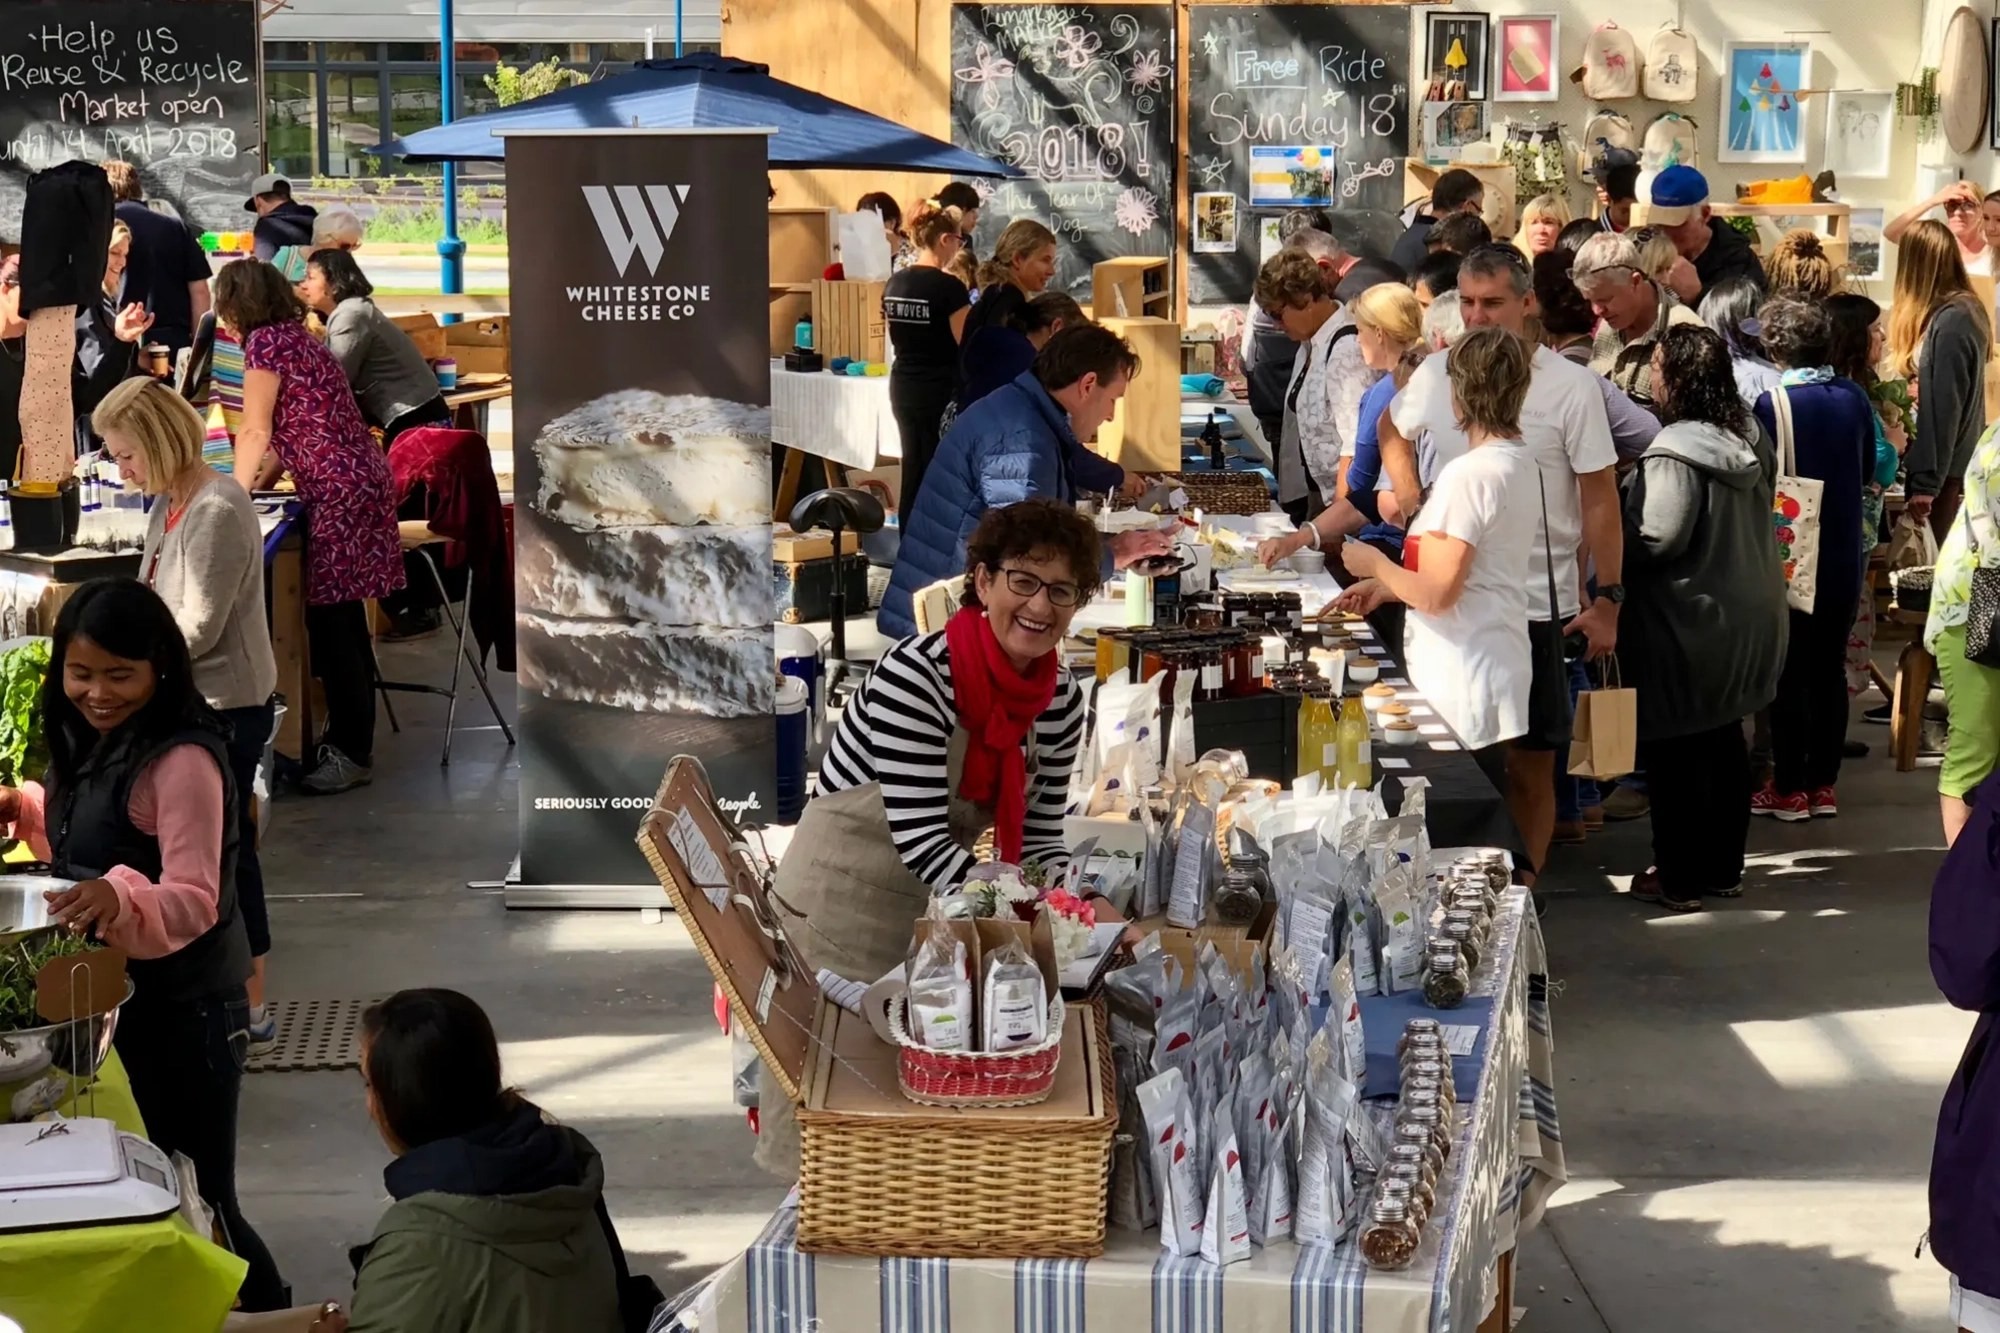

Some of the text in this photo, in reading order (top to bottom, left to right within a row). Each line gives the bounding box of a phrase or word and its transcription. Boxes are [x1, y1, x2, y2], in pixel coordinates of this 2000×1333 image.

[41, 20, 179, 61] Help us
[1, 52, 249, 98] Reuse & Recycle
[1233, 45, 1386, 85] Free Ride
[58, 89, 224, 125] Market open
[1209, 92, 1350, 148] Sunday
[63, 128, 88, 159] 14
[103, 125, 153, 162] April
[167, 127, 238, 159] 2018
[1050, 212, 1088, 243] Dog
[565, 285, 711, 302] WHITESTONE
[896, 303, 931, 319] WOVEN
[581, 304, 662, 321] CHEESE
[534, 797, 608, 810] SERIOUSLY
[611, 797, 654, 809] GOOD
